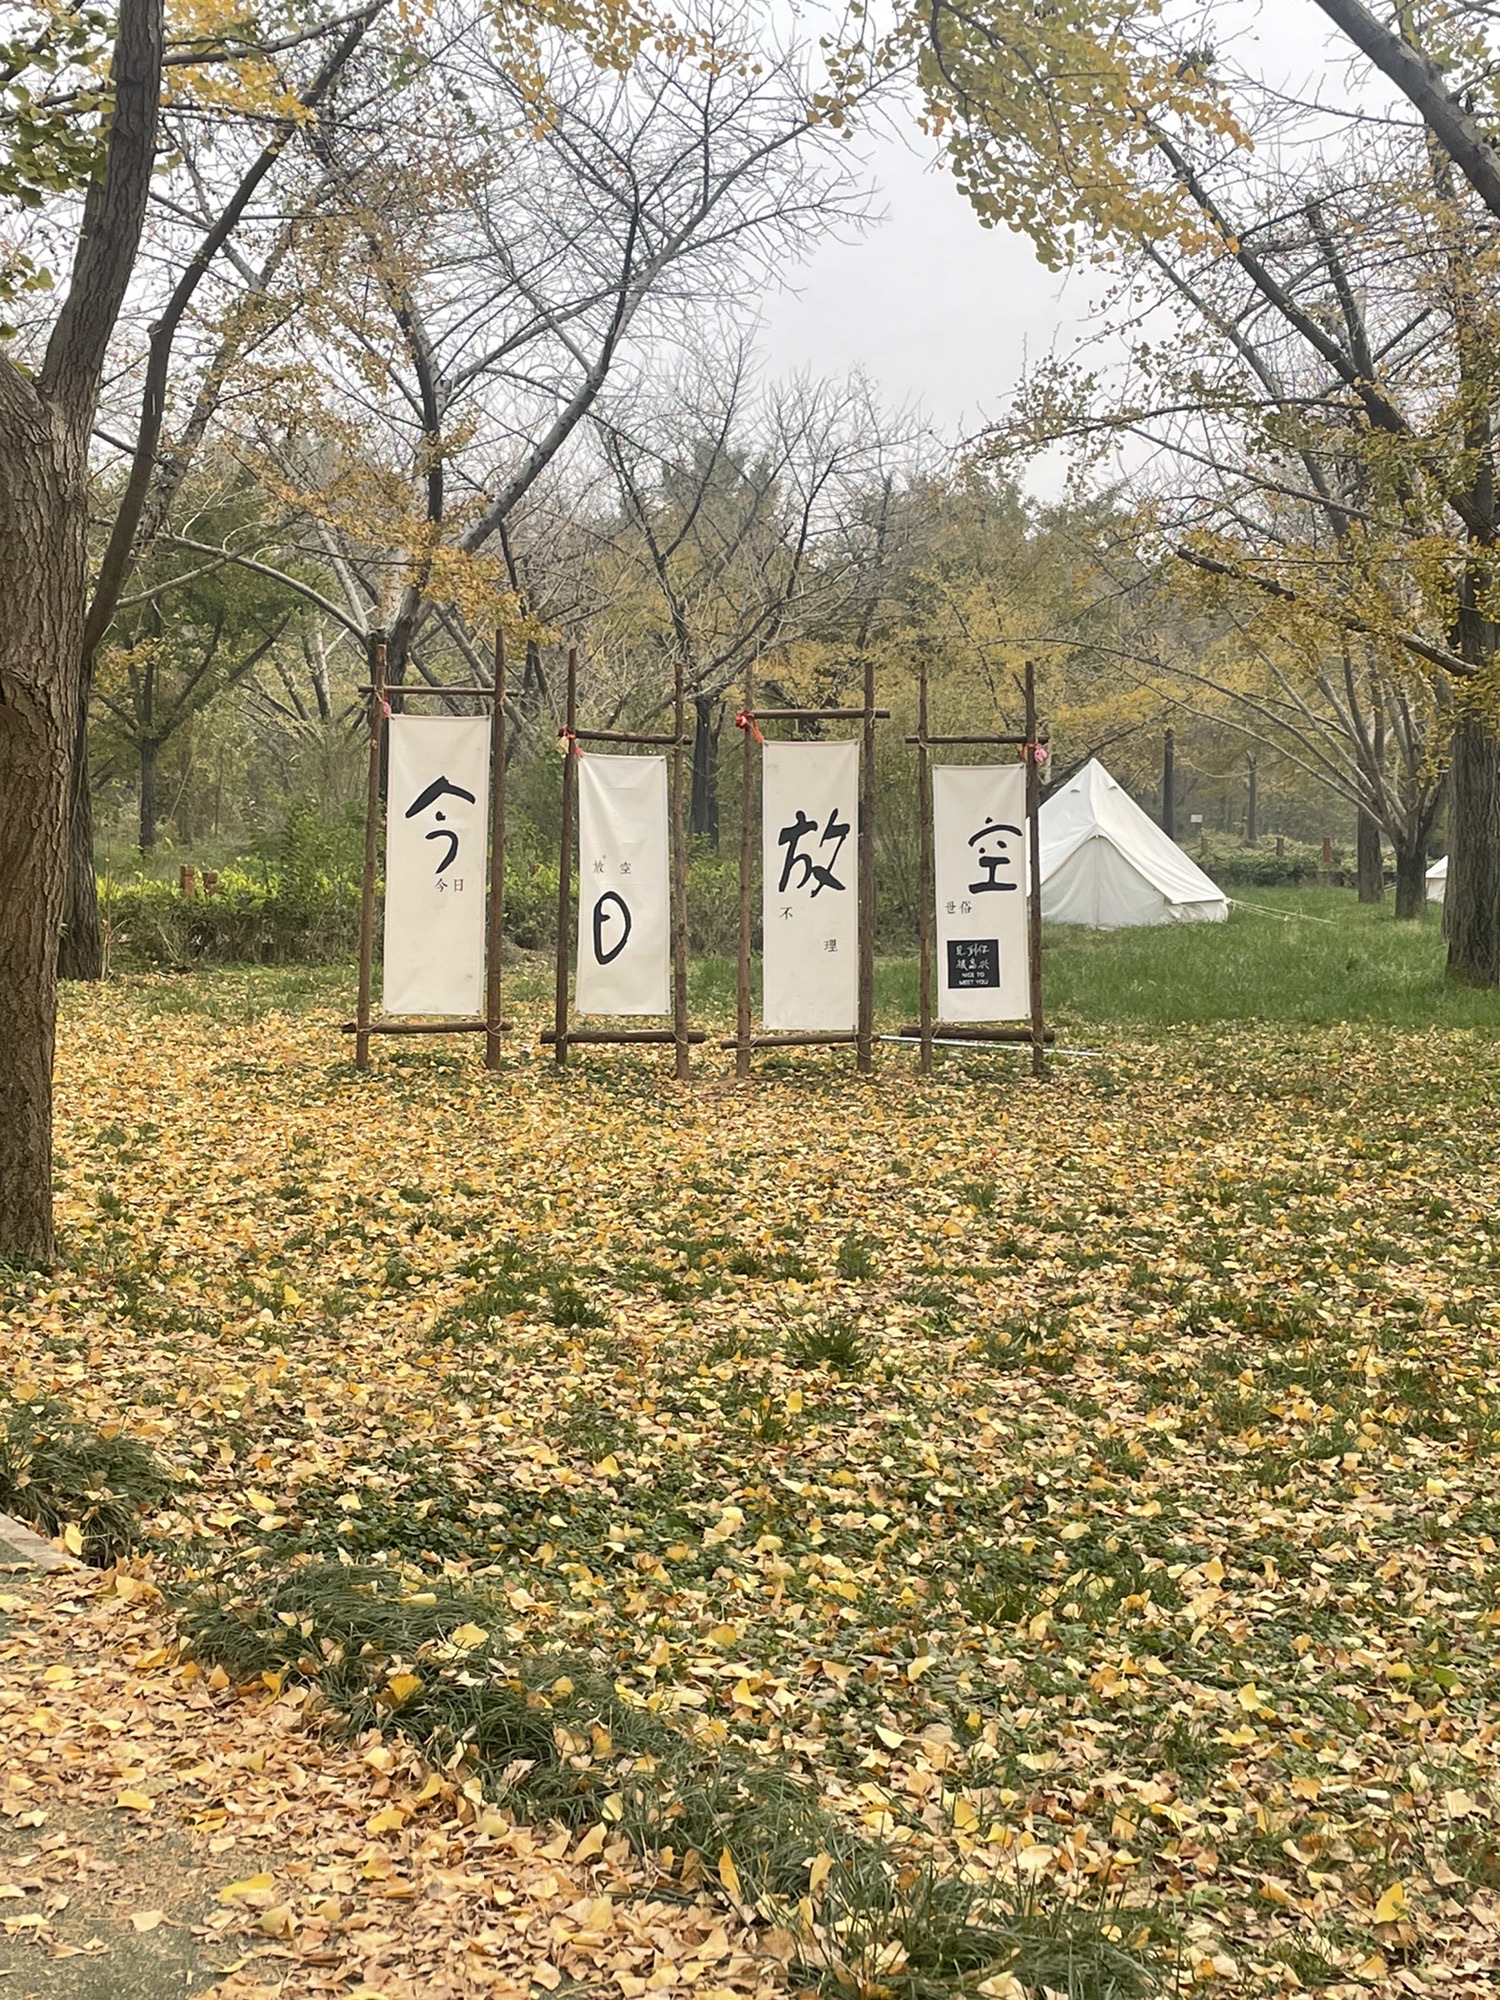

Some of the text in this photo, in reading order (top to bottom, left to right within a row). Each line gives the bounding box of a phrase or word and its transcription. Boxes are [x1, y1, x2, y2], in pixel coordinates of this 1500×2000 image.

[405, 776, 476, 874] 今
[778, 808, 851, 899] 放
[967, 816, 1023, 895] 空
[434, 878, 464, 893] 今日
[945, 901, 972, 914] 世俗
[593, 891, 632, 965] 日
[779, 907, 794, 920] 不
[823, 939, 838, 954] 理
